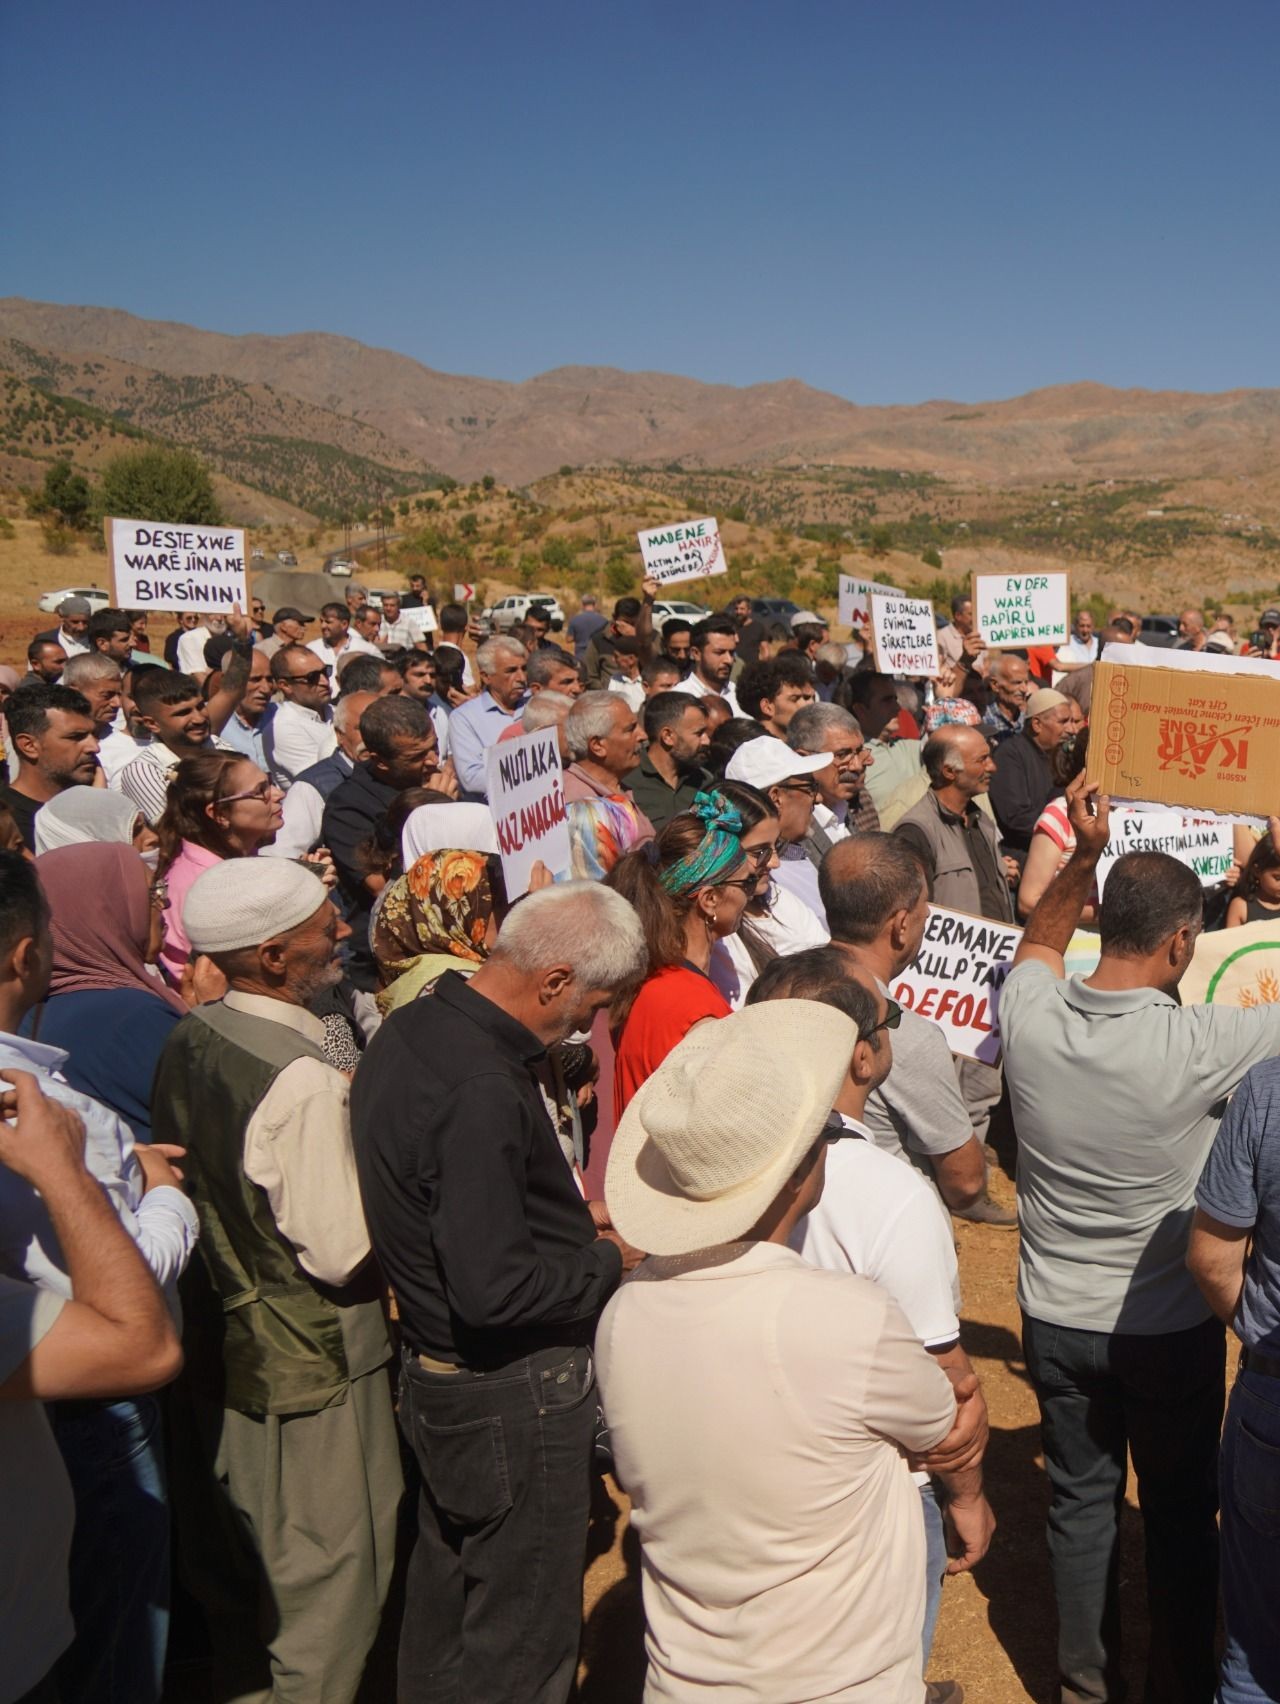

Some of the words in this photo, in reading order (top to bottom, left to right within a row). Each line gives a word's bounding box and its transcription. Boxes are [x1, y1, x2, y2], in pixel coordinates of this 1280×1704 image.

[135, 528, 194, 550] DESTE
[197, 534, 235, 551] XWE
[678, 535, 712, 552] HAYIR
[124, 550, 180, 572] WARÊ
[184, 552, 222, 573] JÎNA
[225, 558, 246, 573] ME
[1006, 577, 1022, 592] EV
[1025, 576, 1048, 591] DER
[885, 602, 897, 614] BU
[900, 601, 931, 617] DAĞLAR
[881, 633, 933, 651] ŞİRKETLERE
[1187, 698, 1207, 708] Kat
[1209, 699, 1228, 710] Çift
[1163, 705, 1199, 719] Tuvalet
[1200, 708, 1233, 722] Çekme
[1235, 713, 1262, 727] İçten
[1159, 719, 1218, 737] STONE
[499, 740, 559, 793] MUTLAKA
[1124, 819, 1143, 836] EV
[924, 914, 1016, 961] ERMAYE
